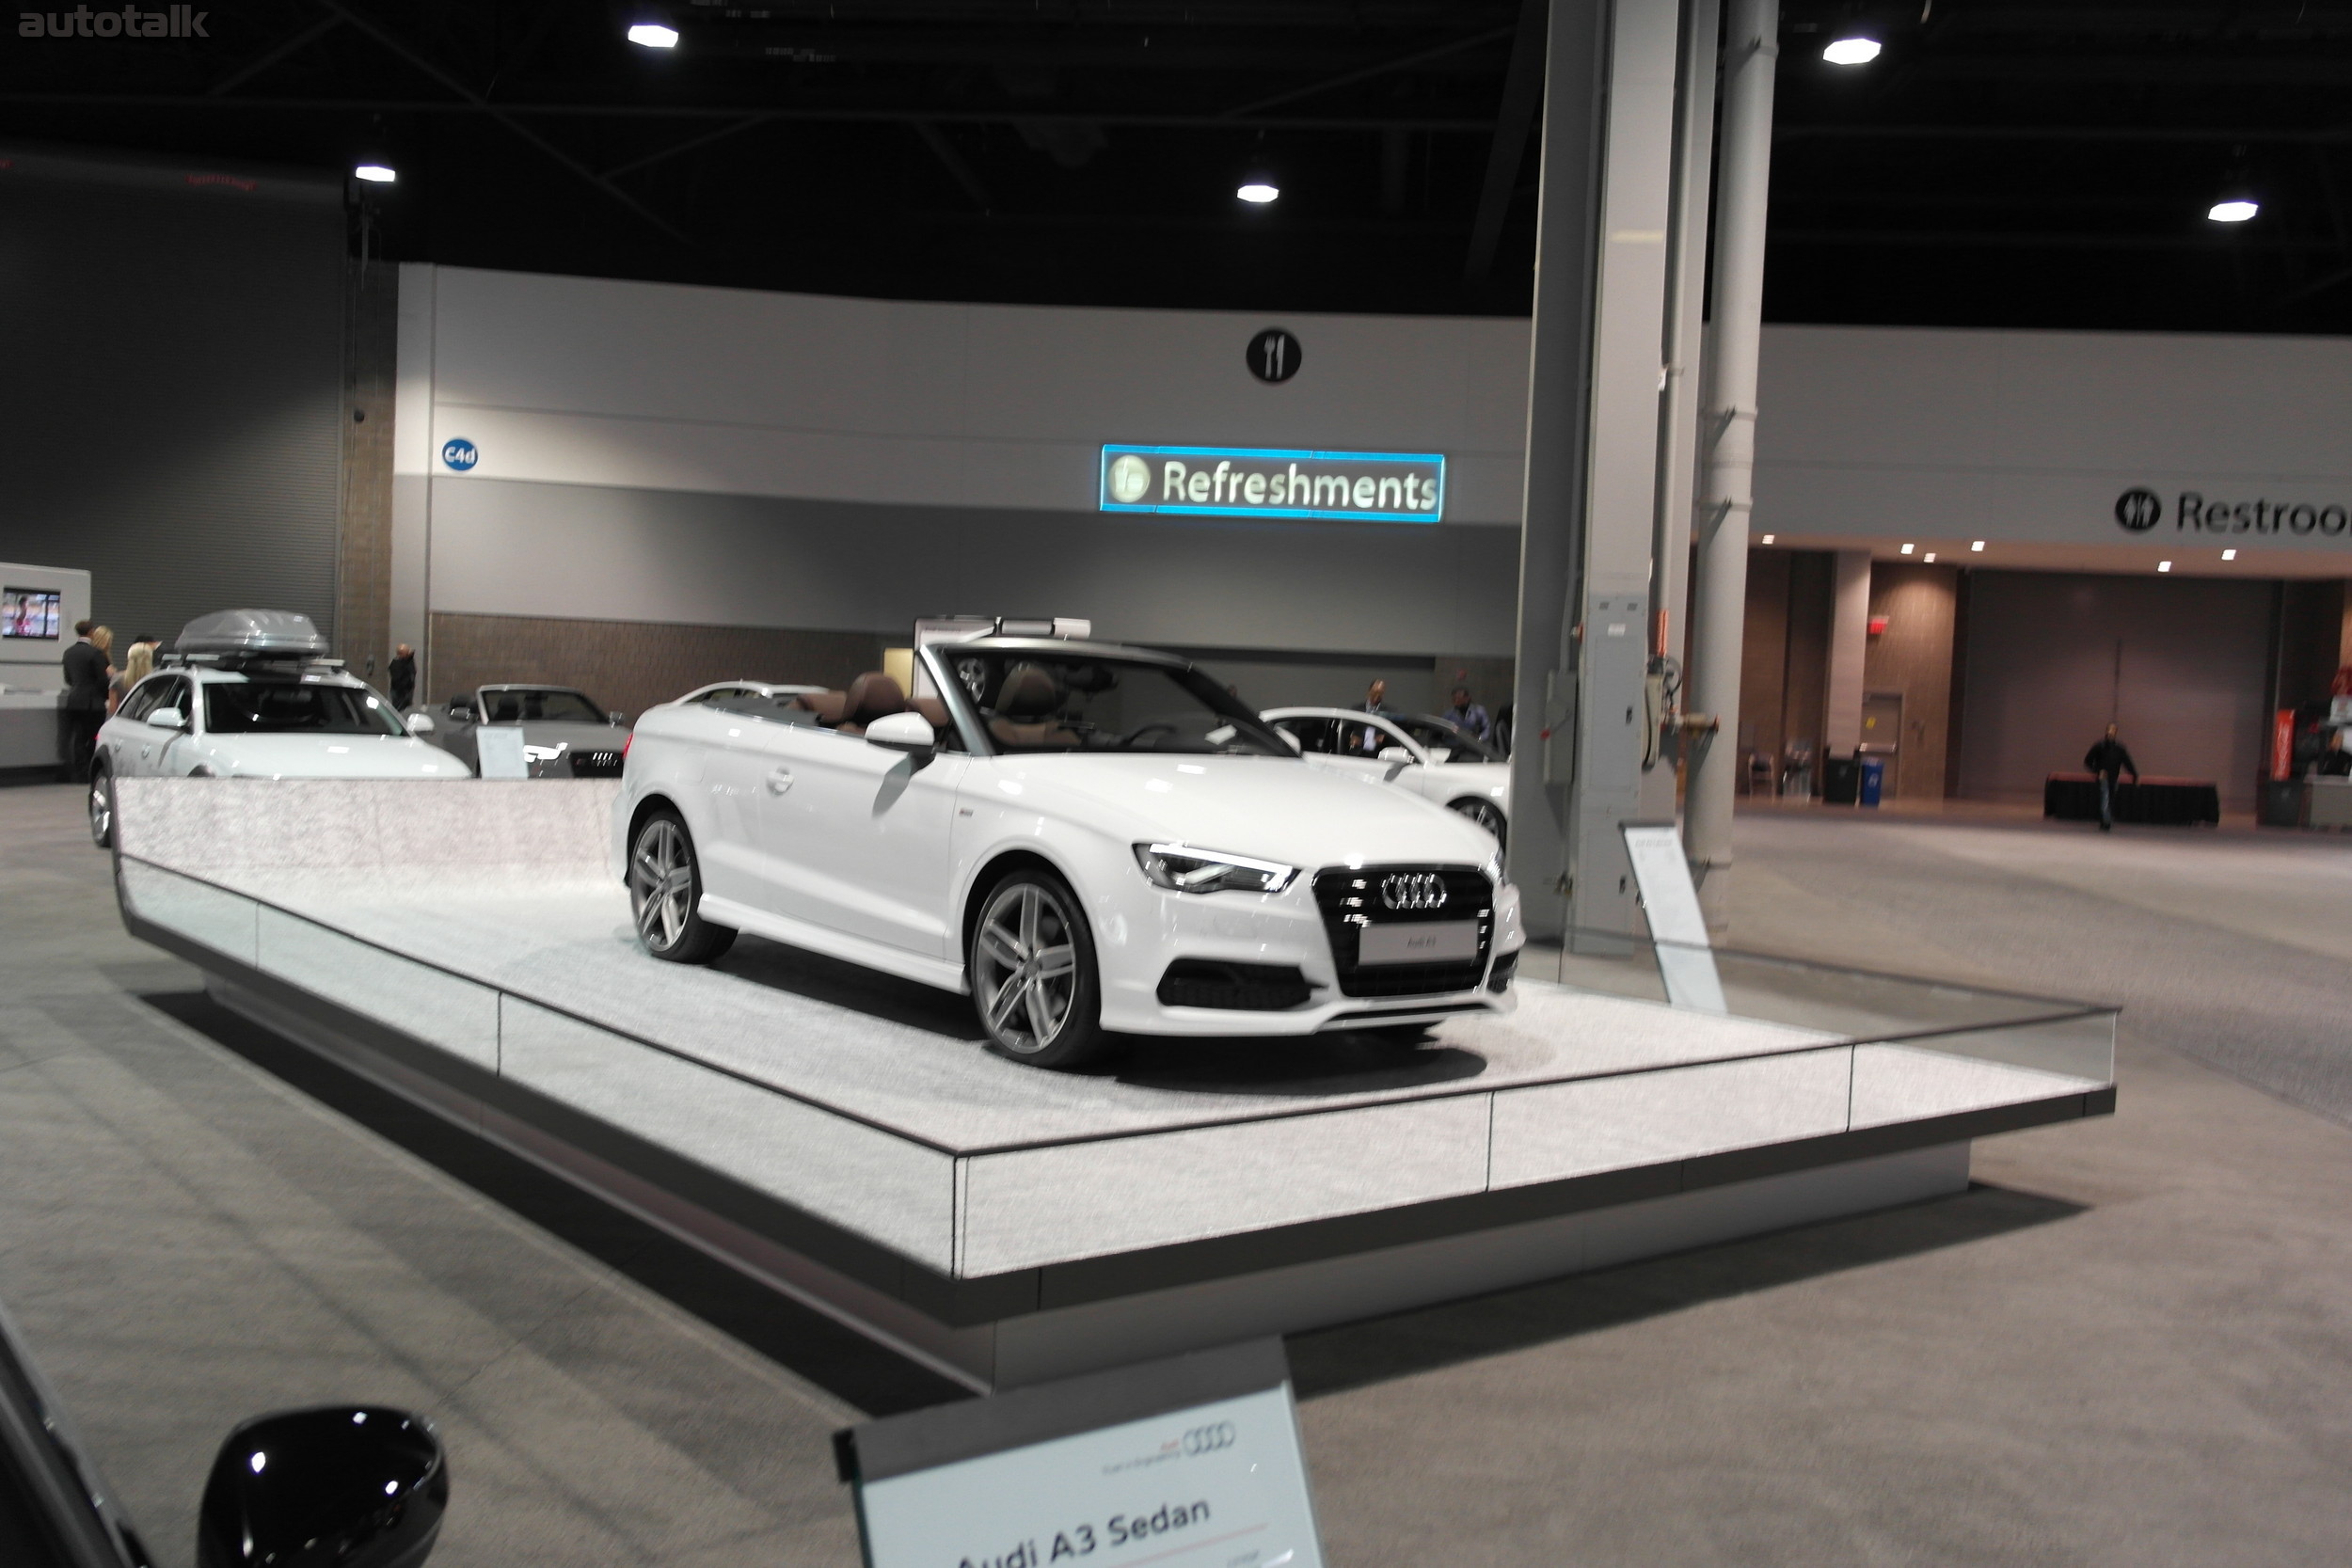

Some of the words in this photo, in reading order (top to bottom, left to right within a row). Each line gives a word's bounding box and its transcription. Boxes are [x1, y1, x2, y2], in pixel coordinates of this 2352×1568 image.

[445, 446, 475, 464] C4d
[1163, 460, 1438, 510] Refreshments
[2176, 490, 2352, 536] Restroo
[1050, 1524, 1098, 1563] A3
[1106, 1498, 1210, 1547] Sedan
